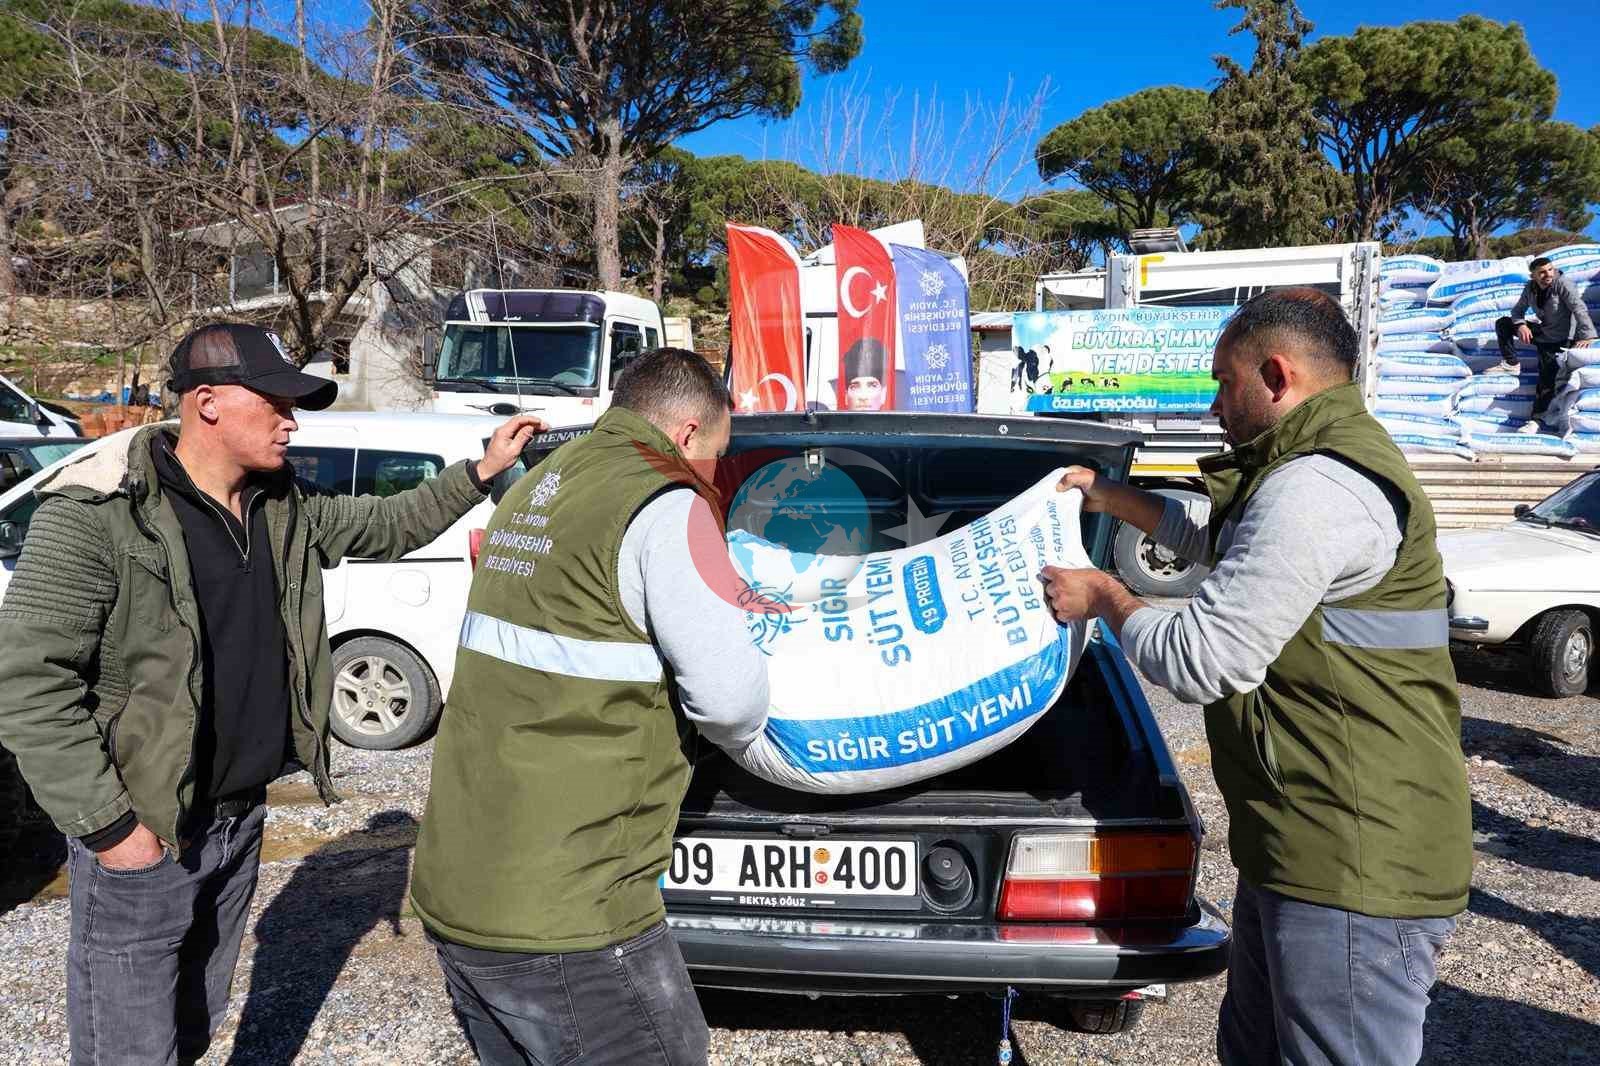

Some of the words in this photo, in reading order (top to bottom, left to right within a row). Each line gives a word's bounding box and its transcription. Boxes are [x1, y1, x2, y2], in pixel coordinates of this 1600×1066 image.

[1093, 312, 1130, 322] AYDIN
[1072, 326, 1165, 352] BÜYÜKBAŞ
[1168, 329, 1219, 348] HAYV
[1091, 353, 1135, 375] YEM
[1136, 348, 1214, 375] DESTEĞ
[1052, 395, 1091, 410] ÖZLEM
[1092, 396, 1157, 411] ÇERÇİOĞLU
[526, 513, 550, 528] AYDIN
[490, 529, 553, 554] BÜYÜKŞEHİR
[485, 555, 535, 576] BELEDİYESİ
[950, 538, 972, 579] AYDIN
[994, 514, 1040, 610] BELEDİYESİ
[812, 577, 853, 642] SIĞIR
[961, 584, 985, 621] T.C.
[922, 607, 940, 626] 19
[866, 609, 911, 666] SÜT
[806, 731, 890, 762] SIĞIR
[897, 716, 956, 754] SÜT
[961, 674, 1033, 733] YEMİ
[669, 842, 714, 886] 09
[738, 844, 812, 889] ARH
[832, 846, 907, 891] 400
[739, 895, 777, 907] BEKTAŞ
[779, 895, 806, 907] OĞUZ
